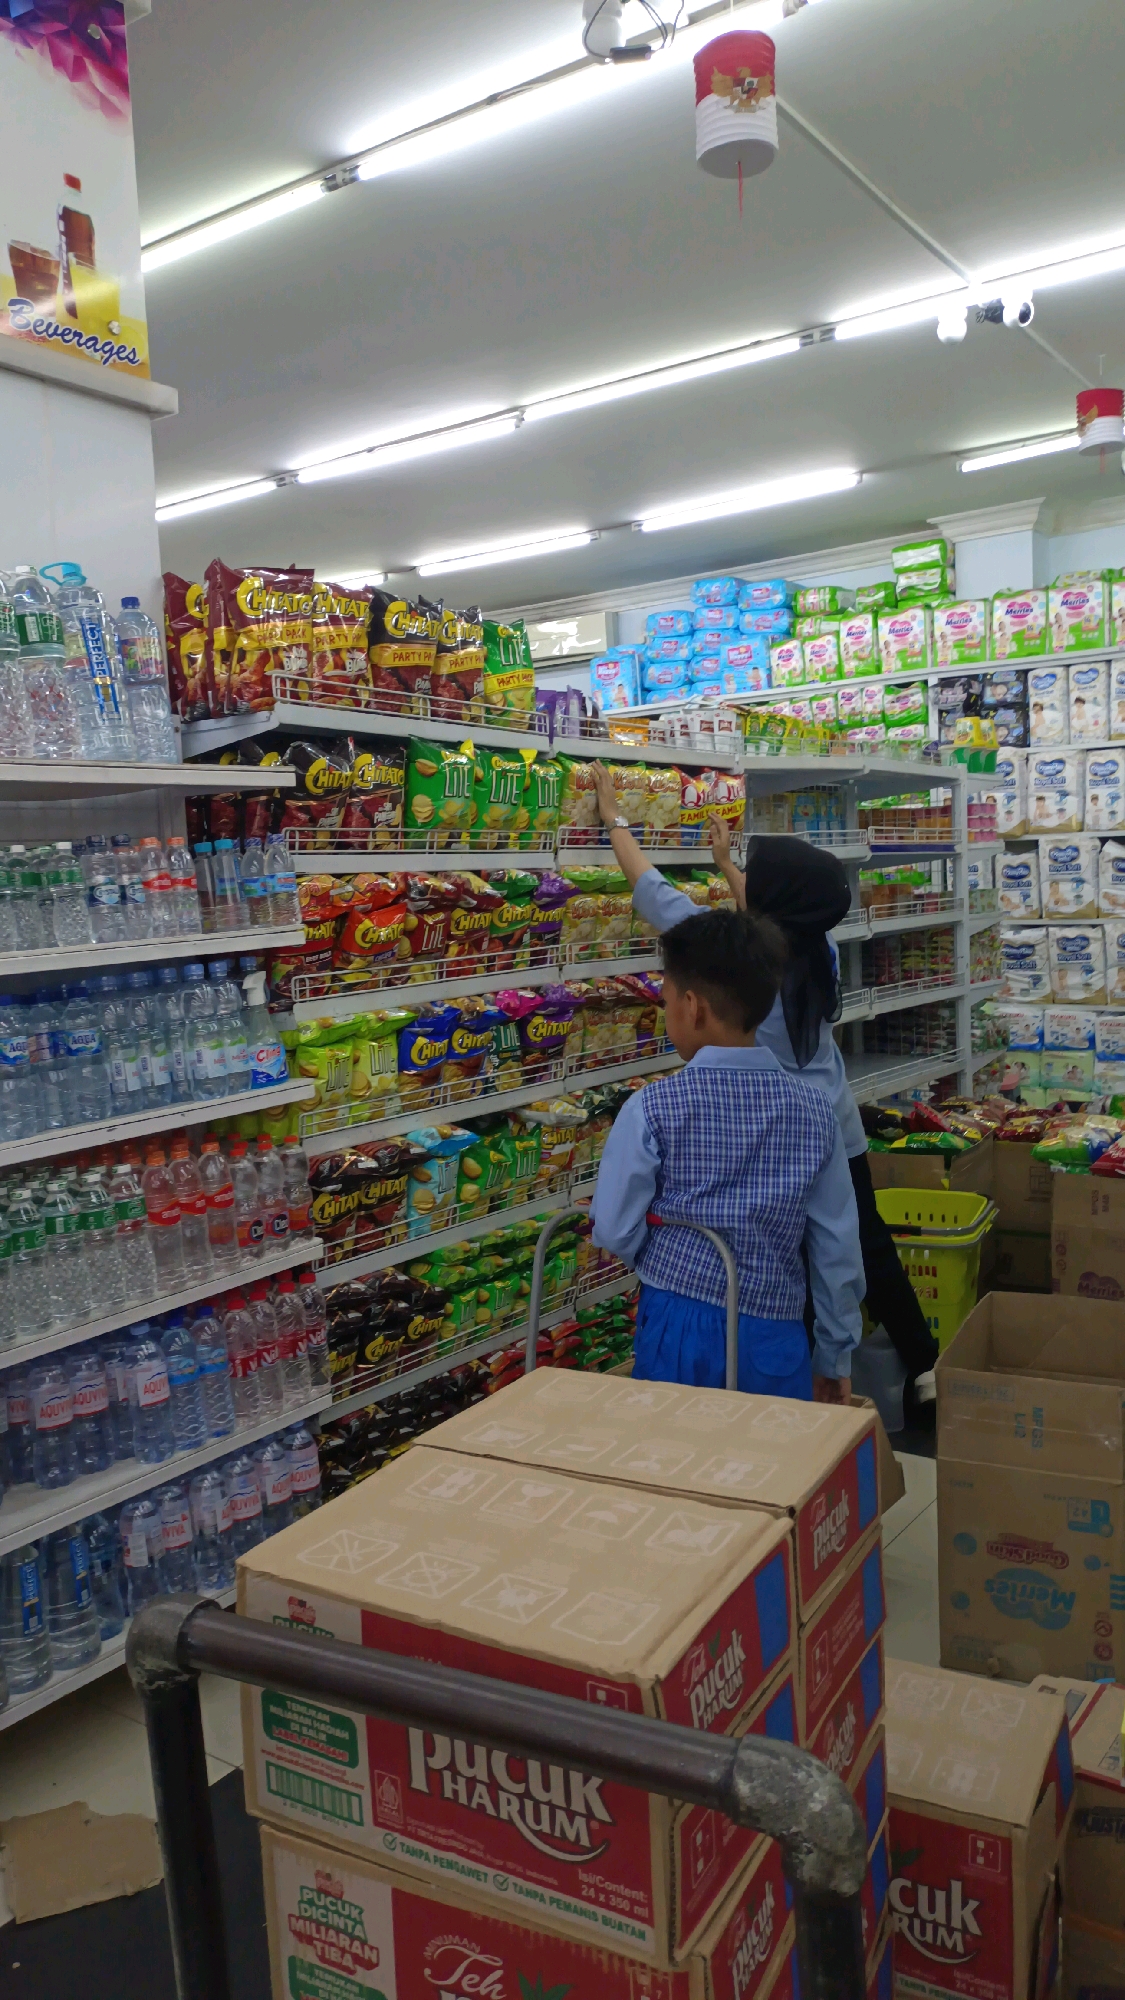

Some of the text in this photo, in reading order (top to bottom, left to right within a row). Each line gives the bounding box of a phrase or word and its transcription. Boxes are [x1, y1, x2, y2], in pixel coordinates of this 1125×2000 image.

[8, 298, 140, 366] Beverages
[1005, 606, 1034, 617] Merries
[1060, 598, 1090, 608] Merries
[846, 629, 868, 638] Merries
[888, 625, 913, 636] Merries
[945, 617, 973, 627] Merries
[86, 622, 109, 678] PERFECT
[392, 650, 434, 666] PARTY PA
[449, 652, 474, 671] PARTY
[497, 674, 520, 691] PARTY
[305, 757, 354, 795] CHiTAT
[450, 907, 491, 937] CHiTAT
[9, 1043, 29, 1055] AQU
[71, 1034, 97, 1046] AQUA
[410, 1036, 449, 1066] CHiTAT
[313, 1191, 360, 1224] CHiTAT
[408, 1315, 445, 1342] CHiTAT
[984, 1577, 1076, 1612] Merries
[442, 1770, 593, 1849] HARUM
[302, 1888, 364, 1923] PUCUK
[581, 1883, 649, 1919] 24 x 350 ml
[299, 1904, 366, 1938] DICINTA
[549, 1896, 600, 1922] PEMANIS
[601, 1911, 647, 1941] BUATAN
[892, 1911, 965, 1955] RUM
[290, 1916, 379, 1964] MILIARAN
[423, 1934, 481, 1963] MINUMAN
[313, 1941, 355, 1971] TIBA
[423, 1944, 507, 2000] Teh
